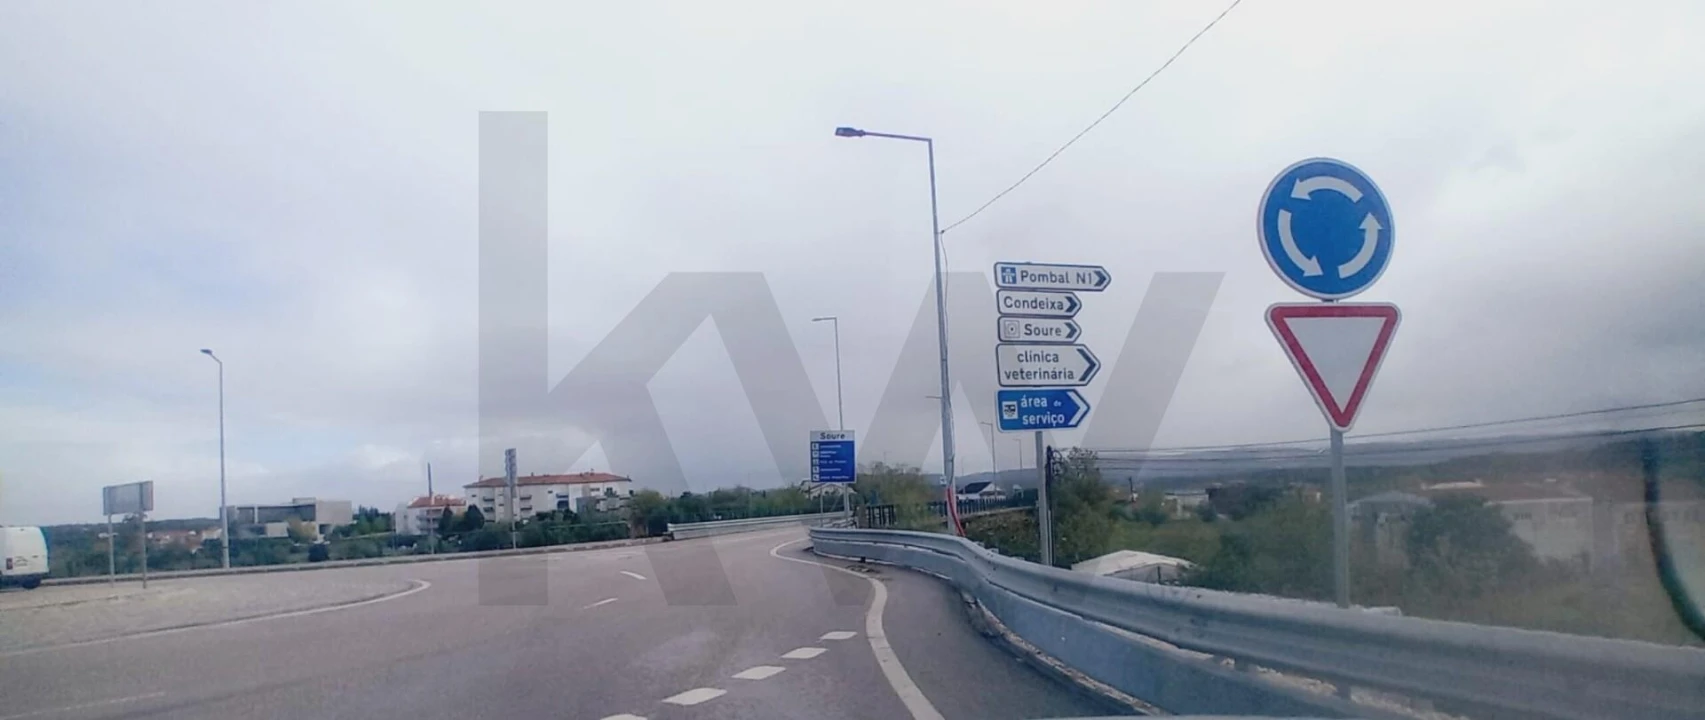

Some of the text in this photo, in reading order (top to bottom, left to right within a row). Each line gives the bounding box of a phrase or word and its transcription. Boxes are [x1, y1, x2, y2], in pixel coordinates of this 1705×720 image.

[1020, 270, 1092, 285] Pombal N1
[1003, 296, 1064, 310] Condeixa
[1024, 324, 1062, 336] Soure
[1017, 350, 1060, 363] clínica
[1004, 367, 1075, 380] veterinária
[1020, 394, 1048, 408] área
[1022, 411, 1065, 427] serviço
[820, 432, 846, 440] Soure
